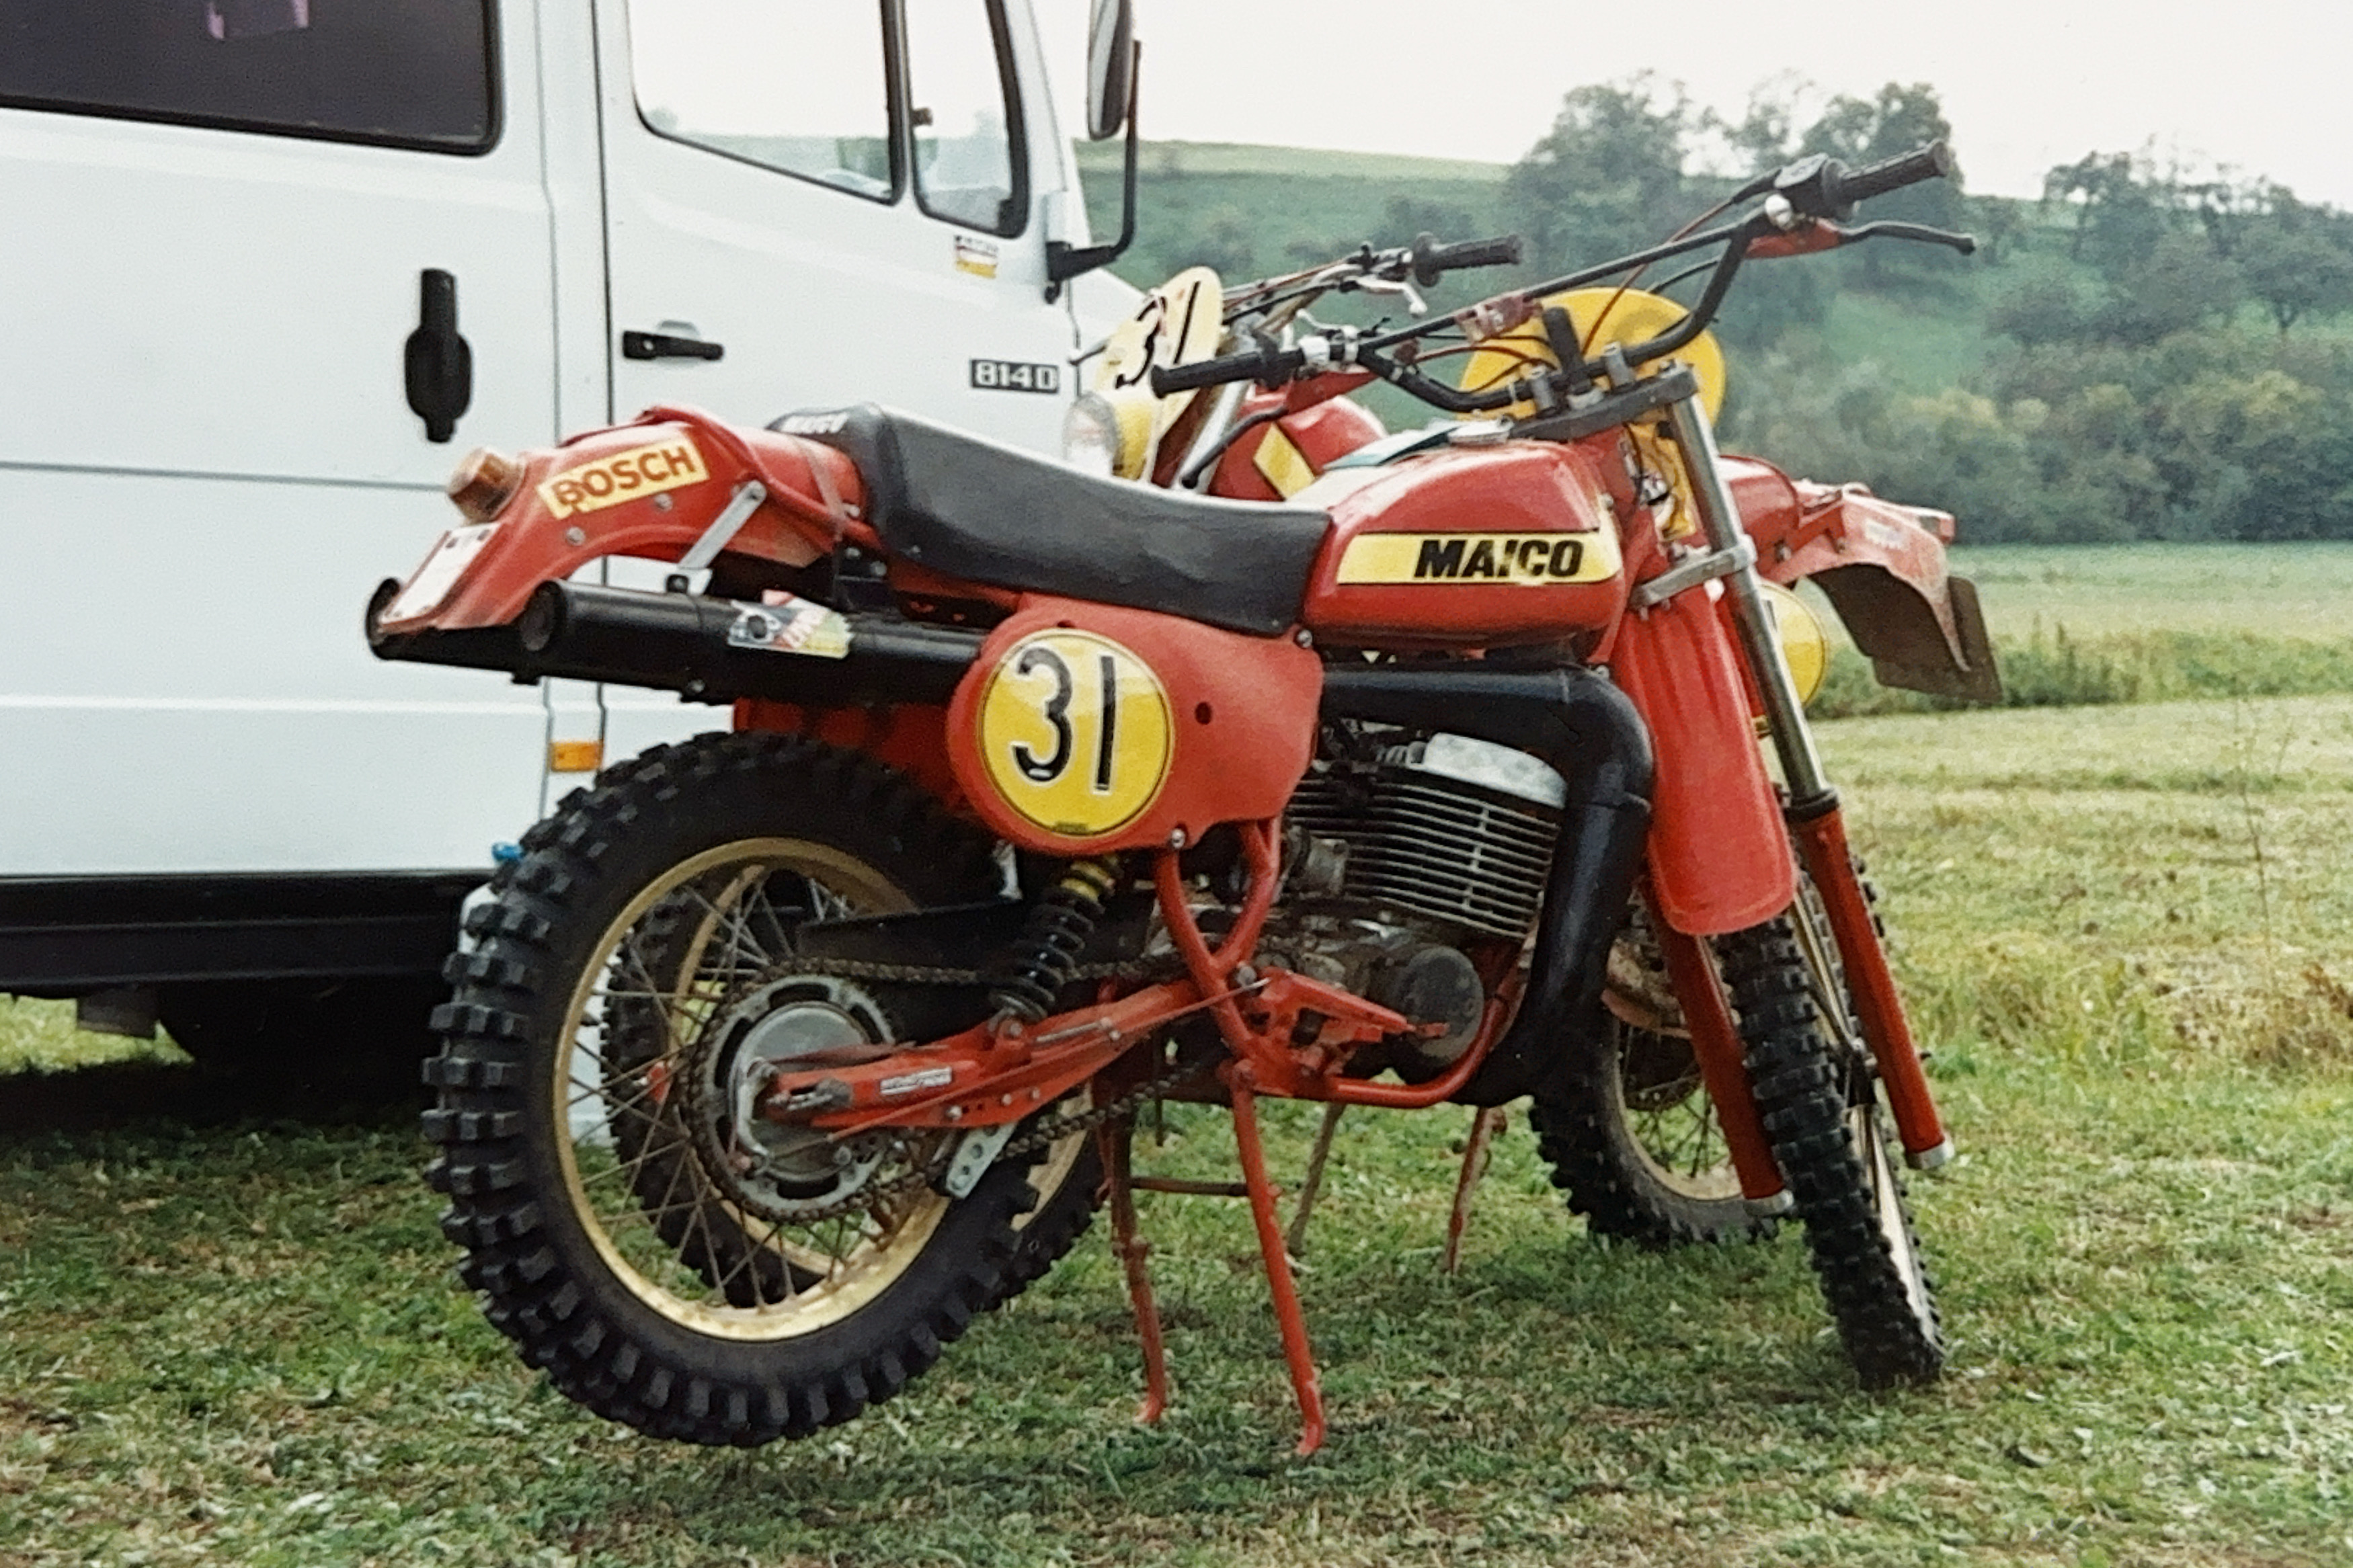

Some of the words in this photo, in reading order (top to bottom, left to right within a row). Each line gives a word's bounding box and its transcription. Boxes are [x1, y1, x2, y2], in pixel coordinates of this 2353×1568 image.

[1115, 280, 1201, 390] 31
[551, 446, 696, 505] BOSCH
[1414, 540, 1584, 578] MAICO
[1011, 646, 1116, 791] 31
